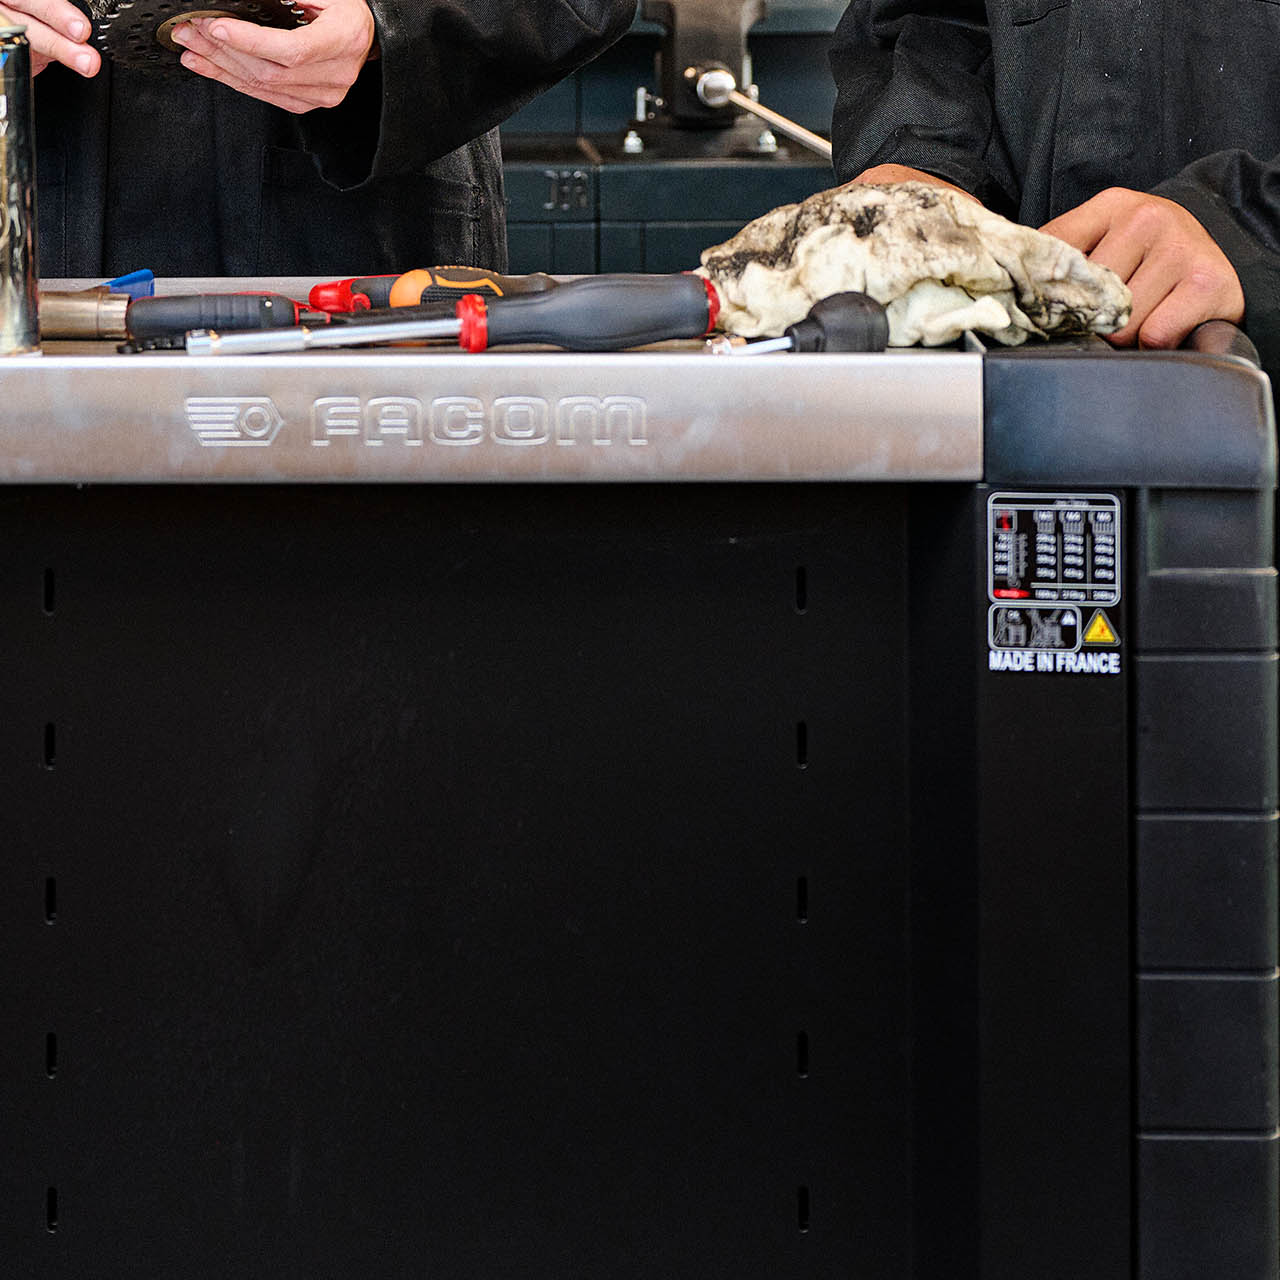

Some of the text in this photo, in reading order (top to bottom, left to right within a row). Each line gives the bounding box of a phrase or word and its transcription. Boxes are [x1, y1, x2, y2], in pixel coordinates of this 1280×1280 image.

[311, 394, 648, 447] FACOM
[989, 650, 1121, 674] MADE IN FRANCE
